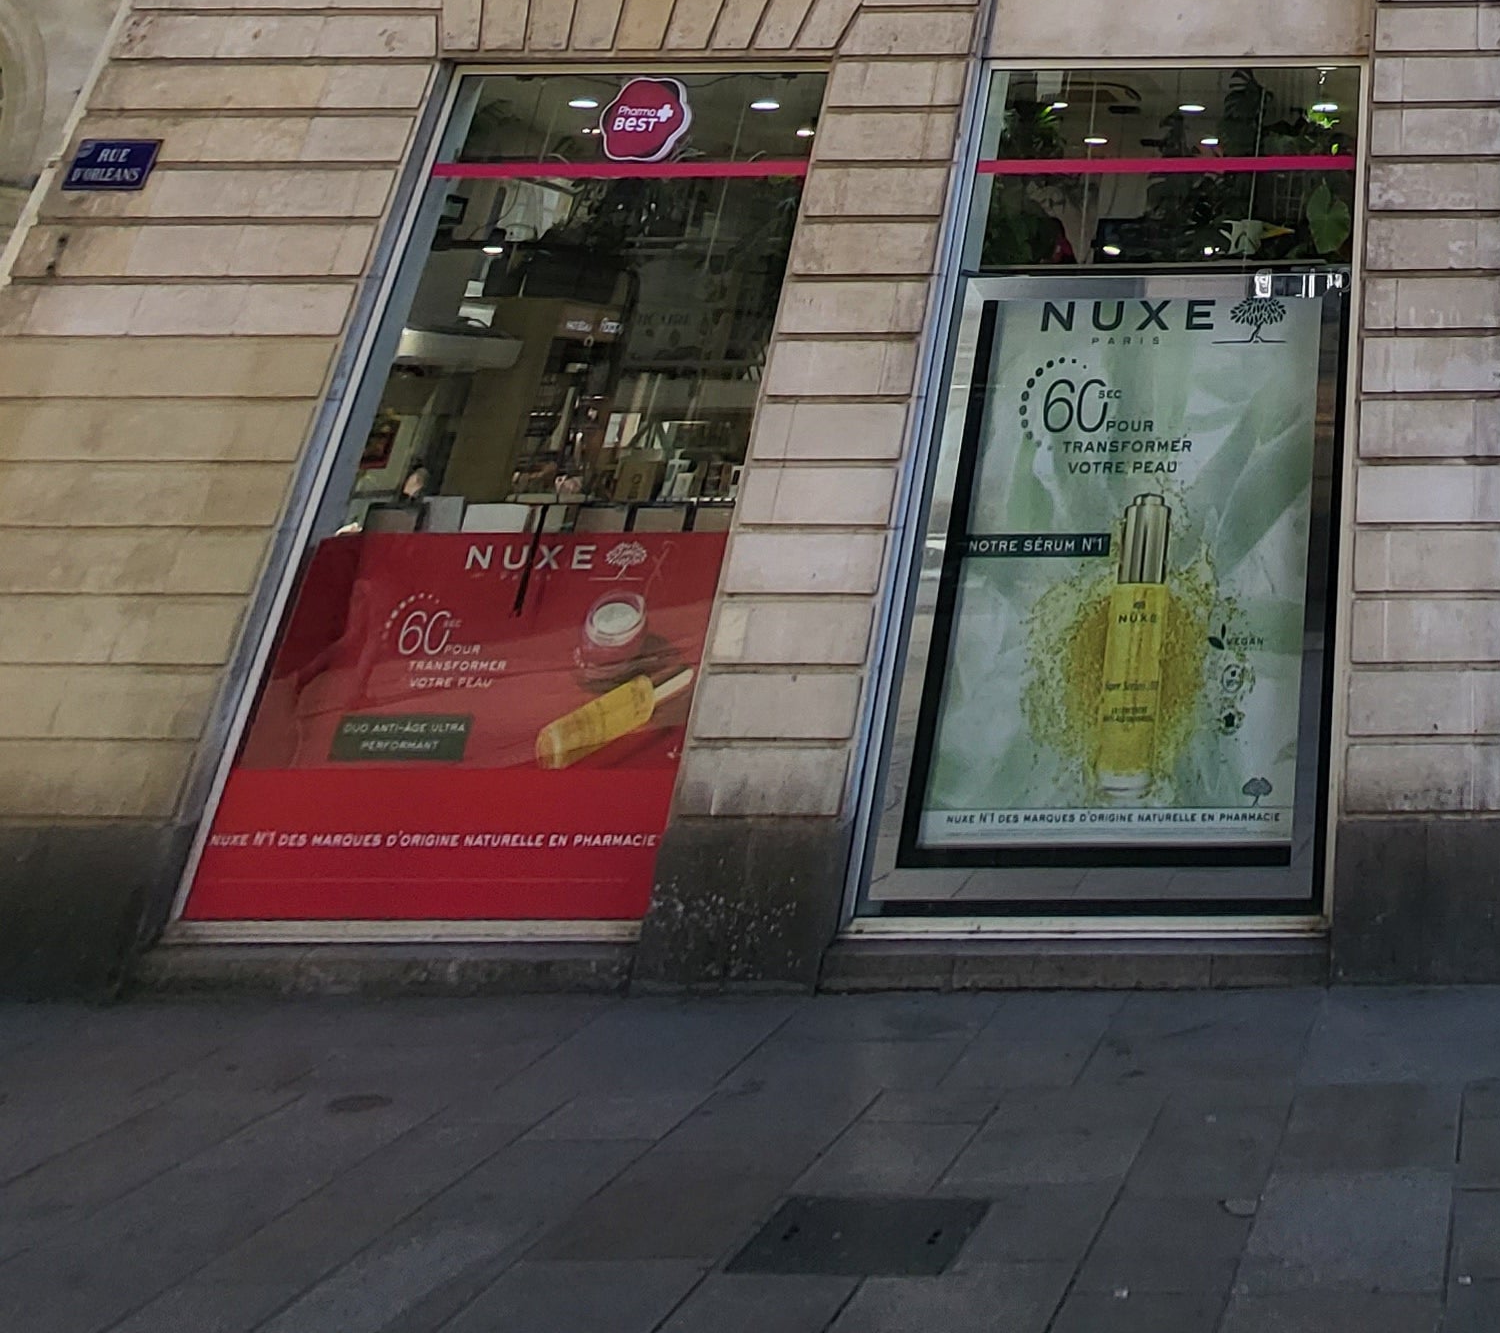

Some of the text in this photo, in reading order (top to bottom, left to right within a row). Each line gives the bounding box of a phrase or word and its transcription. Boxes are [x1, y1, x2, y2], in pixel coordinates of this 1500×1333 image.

[617, 105, 656, 117] Pharma
[96, 148, 131, 163] RUE
[1040, 299, 1216, 332] NUXE
[1091, 336, 1160, 345] PARIS
[1042, 378, 1122, 433] 60 SEC
[1105, 420, 1154, 432] POUR
[1063, 440, 1193, 453] TRANSFORMER
[1068, 460, 1178, 474] VOTRE PEAU
[968, 539, 1018, 552] NOTRE
[1023, 536, 1075, 552] SÉRUM
[465, 544, 598, 571] NUXE
[1118, 613, 1157, 624] NUXE
[398, 609, 452, 656] 60
[1226, 637, 1264, 647] VEGAN
[444, 644, 481, 655] POUR
[408, 659, 507, 672] TRANSFORMER
[409, 676, 493, 688] VOTRE PEAU
[360, 740, 441, 751] PERFORMANT
[946, 814, 976, 824] NUXE
[998, 814, 1019, 824] DES
[1023, 813, 1075, 824] MARQUES
[1079, 811, 1133, 823] D'ORIGINE
[1138, 813, 1197, 823] NATURELLE
[1201, 813, 1215, 823] EN
[1219, 812, 1281, 823] PHARMACIE
[208, 833, 250, 848] NUXE
[278, 833, 308, 848] DES
[311, 833, 382, 847] MARQUES
[385, 830, 460, 847] D'ORIGINE
[463, 834, 545, 847] NATURELLE
[549, 833, 567, 847] EN
[572, 833, 656, 847] PHARMACIE
